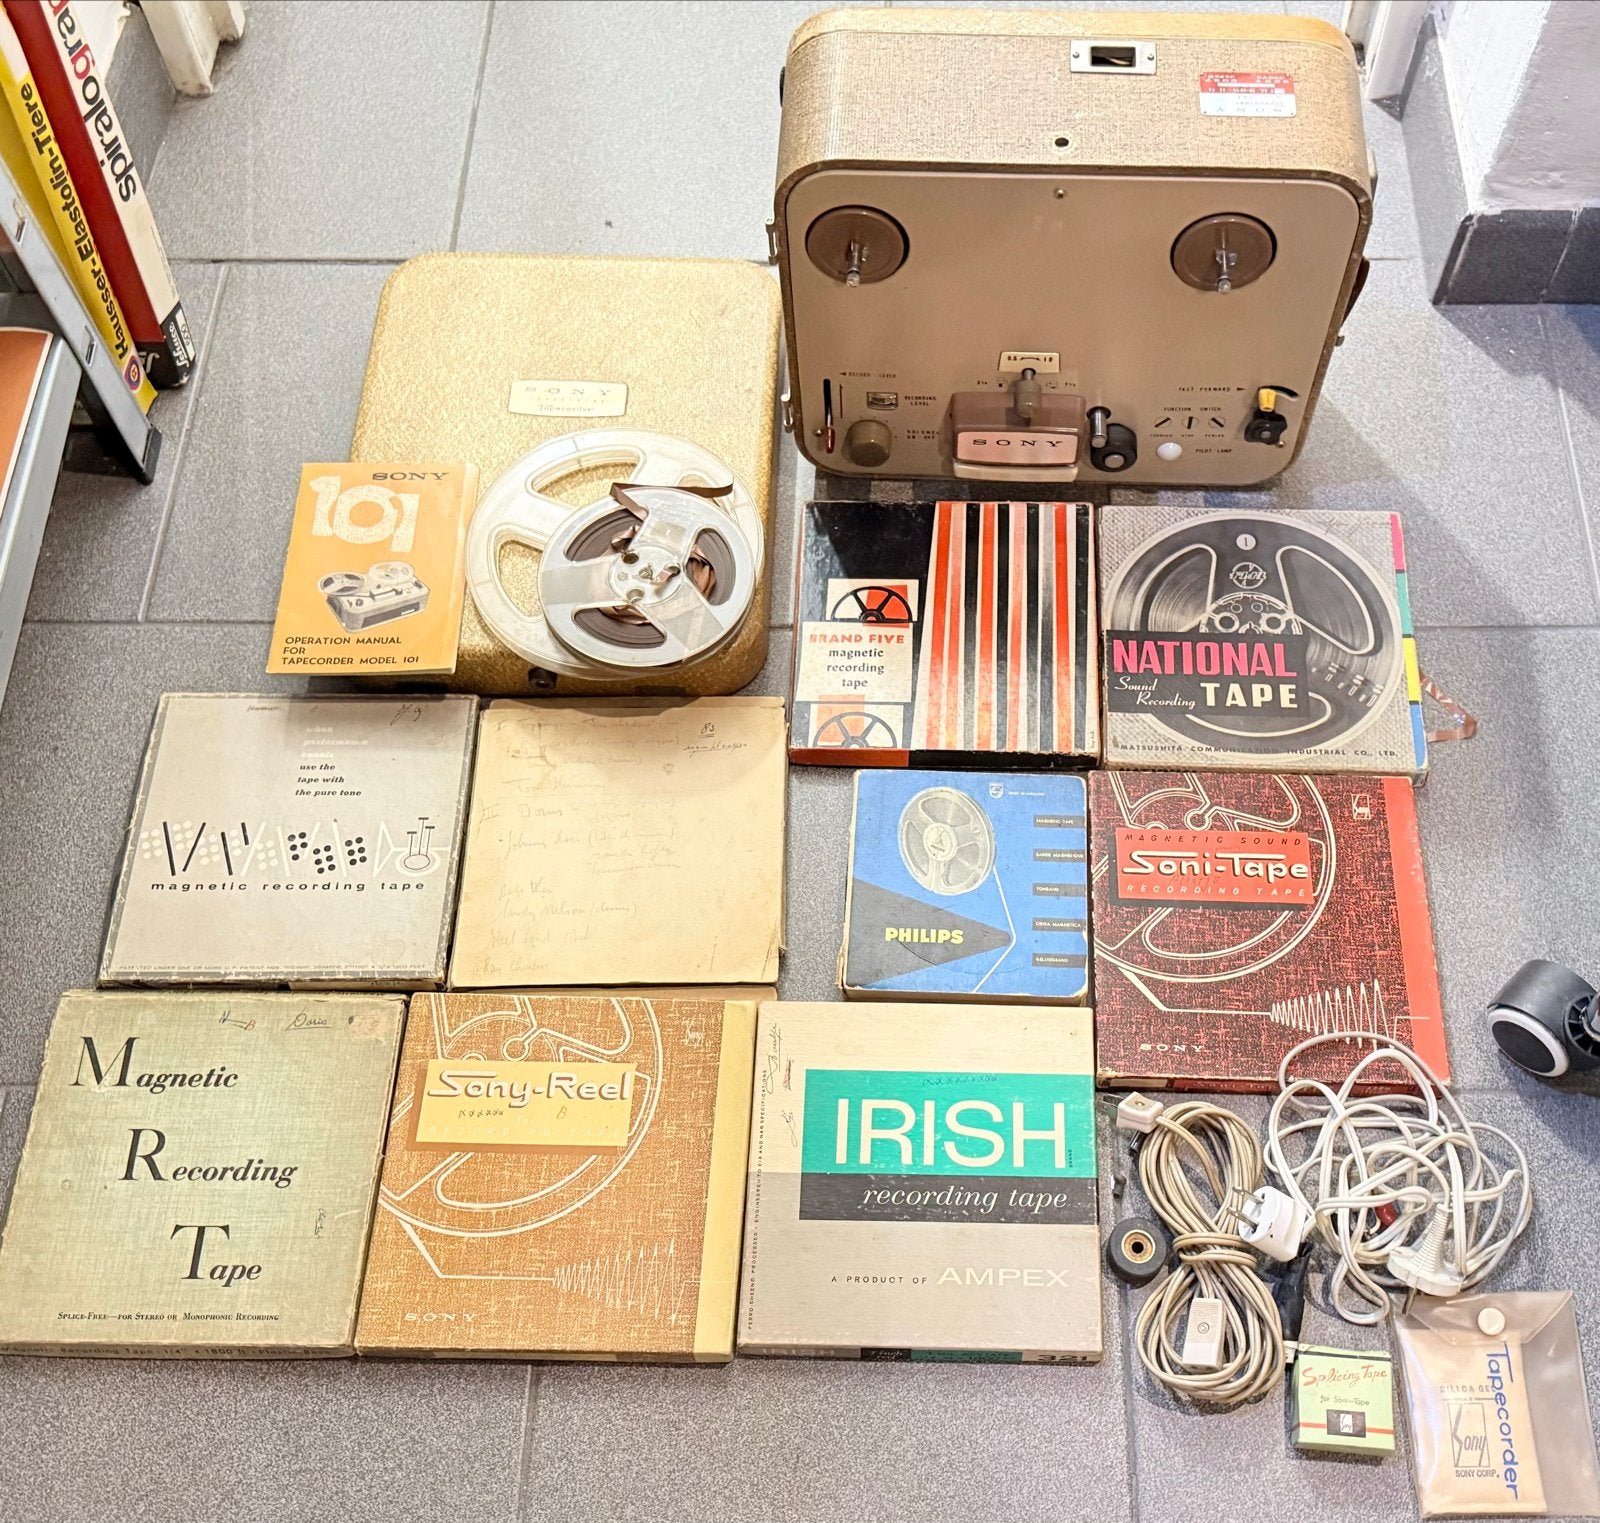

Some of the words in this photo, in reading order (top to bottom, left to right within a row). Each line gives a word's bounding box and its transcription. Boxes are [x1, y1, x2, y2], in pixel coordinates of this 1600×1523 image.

[20, 82, 128, 361] Hausser-Elastolin-Tiere
[972, 438, 1065, 448] SONY
[372, 472, 450, 481] SONY
[308, 475, 421, 553] 101
[285, 636, 351, 645] OPERATION
[356, 636, 402, 645] MANUAL
[809, 634, 863, 644] BRAND
[869, 634, 905, 644] FIVE
[283, 646, 306, 655] FOR
[829, 647, 885, 660] magnetic
[282, 656, 354, 665] TAPECORDER
[359, 656, 398, 664] MODEL
[403, 656, 419, 664] 101
[1112, 639, 1297, 677] NATIONAL
[826, 661, 885, 675] recording
[841, 677, 869, 689] tape
[1114, 676, 1158, 693] Sound
[1136, 691, 1197, 710] Recording
[1200, 682, 1299, 709] TAPE
[1287, 748, 1346, 756] INDUSTRIAL
[297, 776, 319, 784] tape
[322, 776, 345, 784] with
[295, 788, 312, 796] the
[313, 789, 337, 798] pure
[1124, 834, 1223, 844] MAGNETIC
[1240, 836, 1301, 846] SOUND
[1122, 850, 1309, 884] Soni-Tape
[151, 881, 249, 895] magnetic
[262, 881, 366, 894] recording
[380, 881, 426, 893] tape
[1126, 884, 1241, 896] RECORDING
[1256, 888, 1306, 898] TAPE
[885, 927, 964, 945] PHILIPS
[1140, 1042, 1204, 1053] SONY
[69, 1036, 239, 1094] Magnetic
[428, 1070, 631, 1109] Sony-Reel
[429, 1124, 551, 1137] RECORDING
[569, 1127, 622, 1138] TAPE
[835, 1097, 1067, 1169] IRISH
[118, 1128, 299, 1188] Recording
[756, 1168, 762, 1177] TO
[863, 1186, 999, 1214] recording
[1008, 1188, 1068, 1213] tape
[170, 1224, 263, 1288] Tape
[846, 1276, 904, 1285] PRODUCT
[912, 1276, 929, 1285] OF
[937, 1267, 1070, 1288] AMPEX
[404, 1313, 477, 1322] SONY
[1301, 1366, 1361, 1388] Splicing
[1361, 1363, 1388, 1382] Tape
[1320, 1394, 1330, 1404] for
[1486, 1341, 1519, 1500] Tapecorder
[1452, 1403, 1489, 1467] Sony
[1455, 1469, 1476, 1478] SONY
[1477, 1469, 1500, 1478] CORP.
